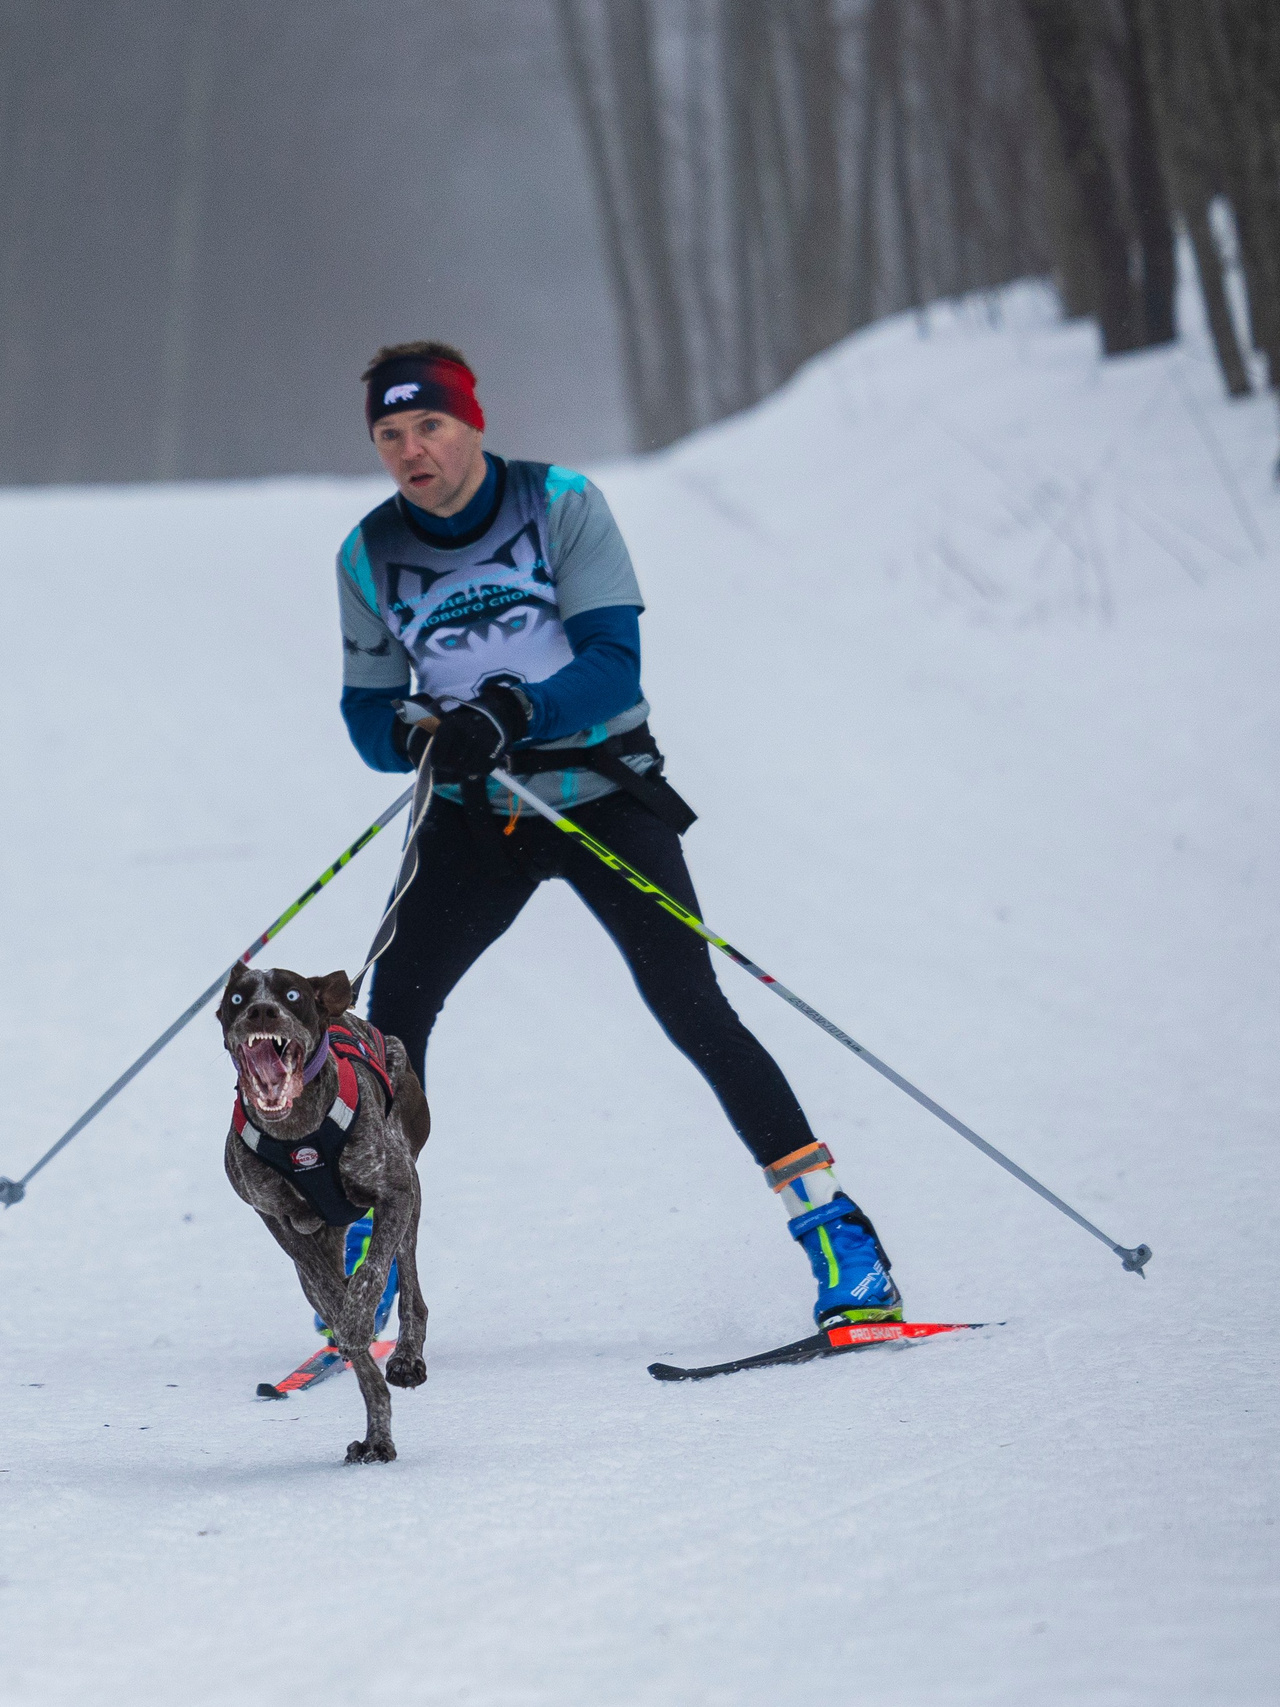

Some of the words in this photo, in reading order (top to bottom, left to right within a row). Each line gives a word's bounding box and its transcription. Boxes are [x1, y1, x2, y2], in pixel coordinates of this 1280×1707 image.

[850, 1259, 883, 1300] SPINE
[849, 1327, 872, 1342] PRO
[871, 1326, 902, 1339] SKATE
